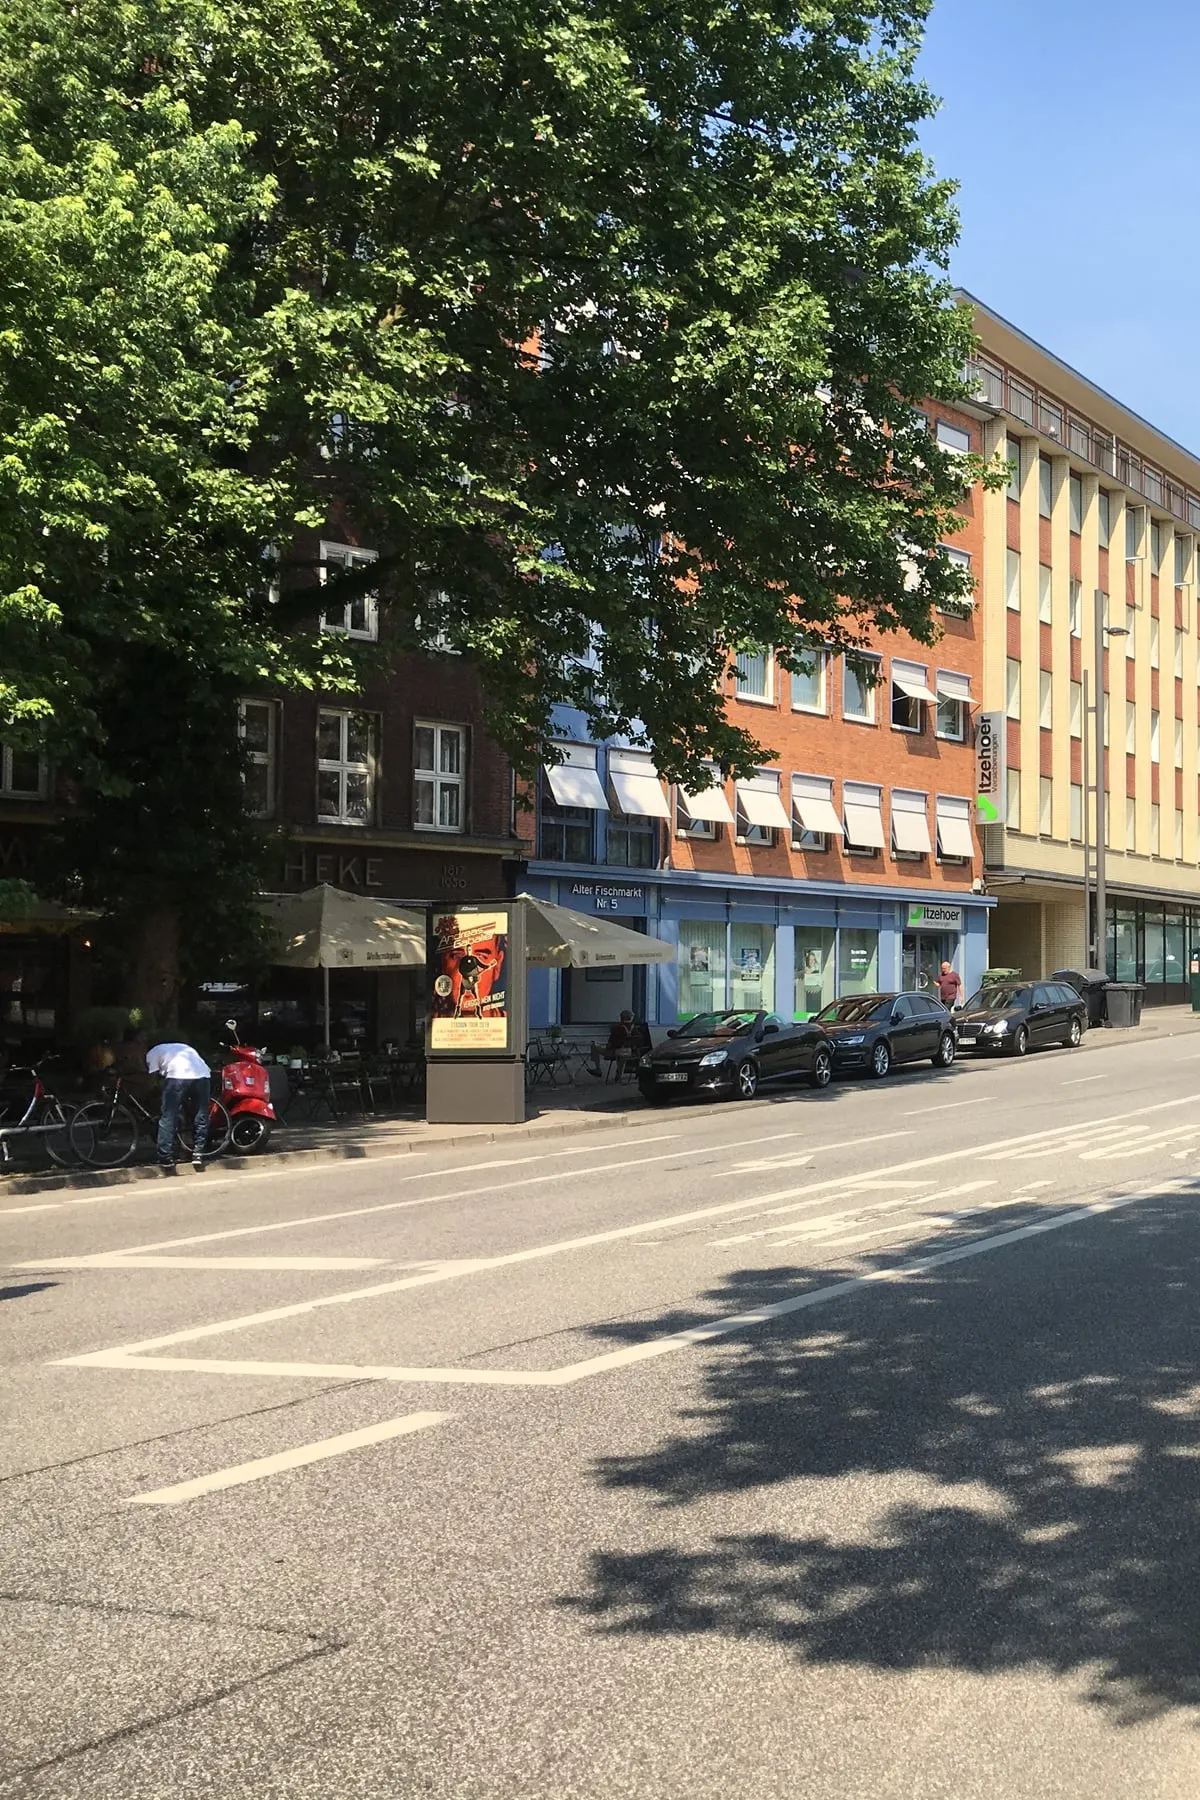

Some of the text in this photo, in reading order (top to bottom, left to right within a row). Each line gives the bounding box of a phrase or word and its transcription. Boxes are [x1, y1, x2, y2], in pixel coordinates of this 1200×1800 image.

[977, 715, 992, 794] Itzehoer
[571, 883, 642, 898] Alter Fischmarkt
[611, 899, 618, 909] 5
[923, 906, 960, 920] Itzehoer
[439, 928, 485, 949] Andreas
